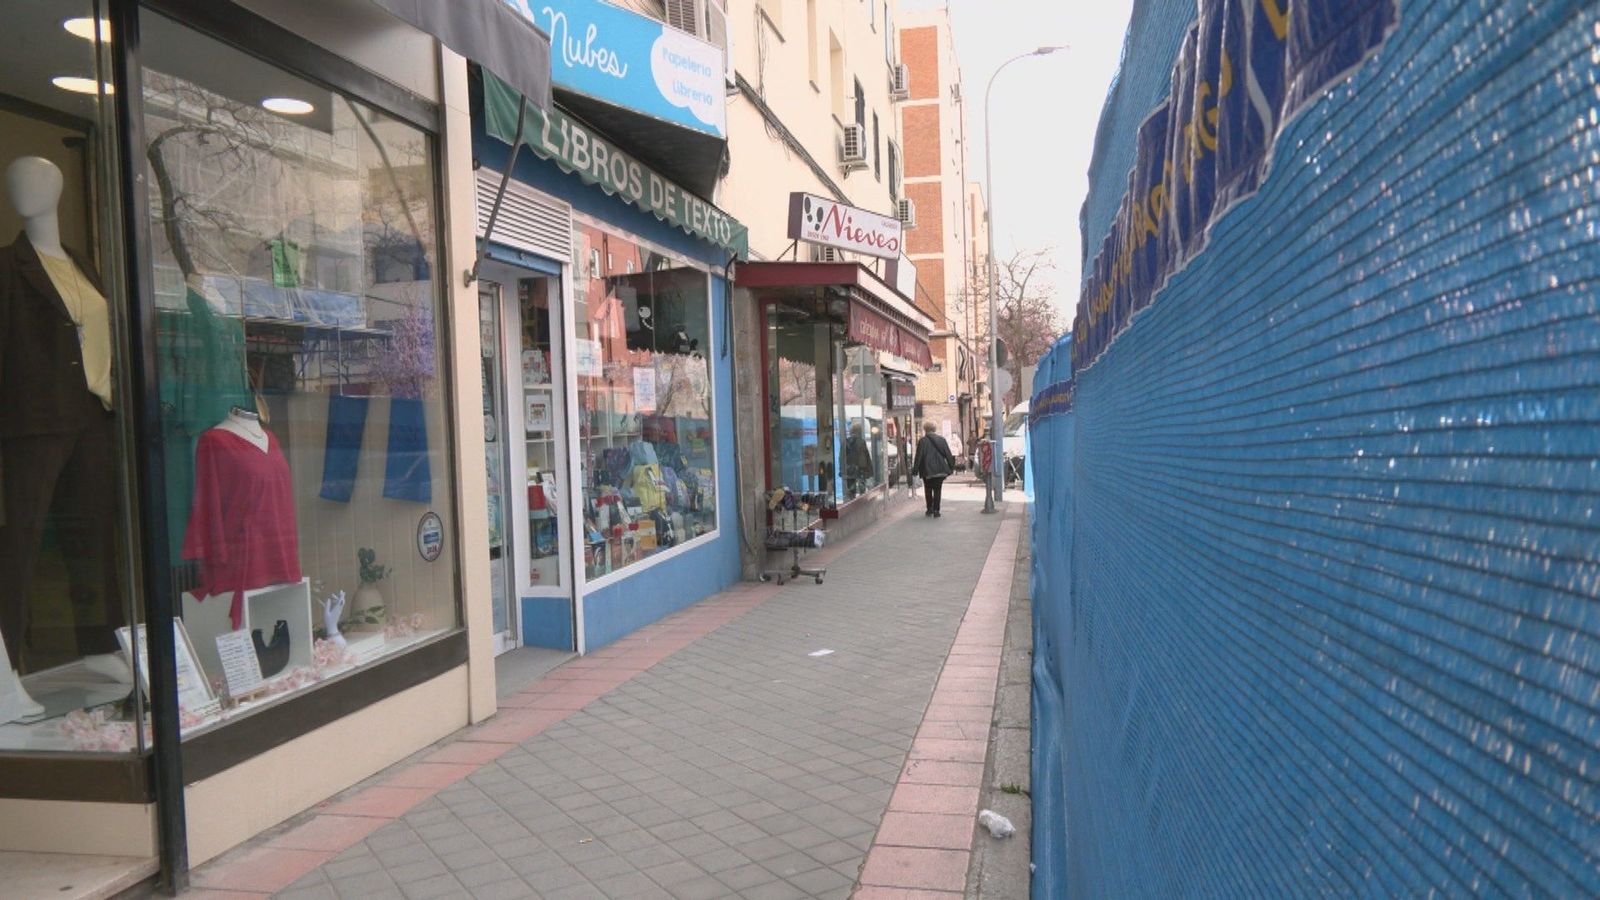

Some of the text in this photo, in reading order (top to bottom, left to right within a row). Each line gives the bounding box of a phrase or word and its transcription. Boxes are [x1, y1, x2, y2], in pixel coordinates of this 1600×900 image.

[542, 6, 628, 78] Nubes
[541, 109, 732, 244] LIBROS DE TEXTO
[822, 204, 898, 251] Nieves
